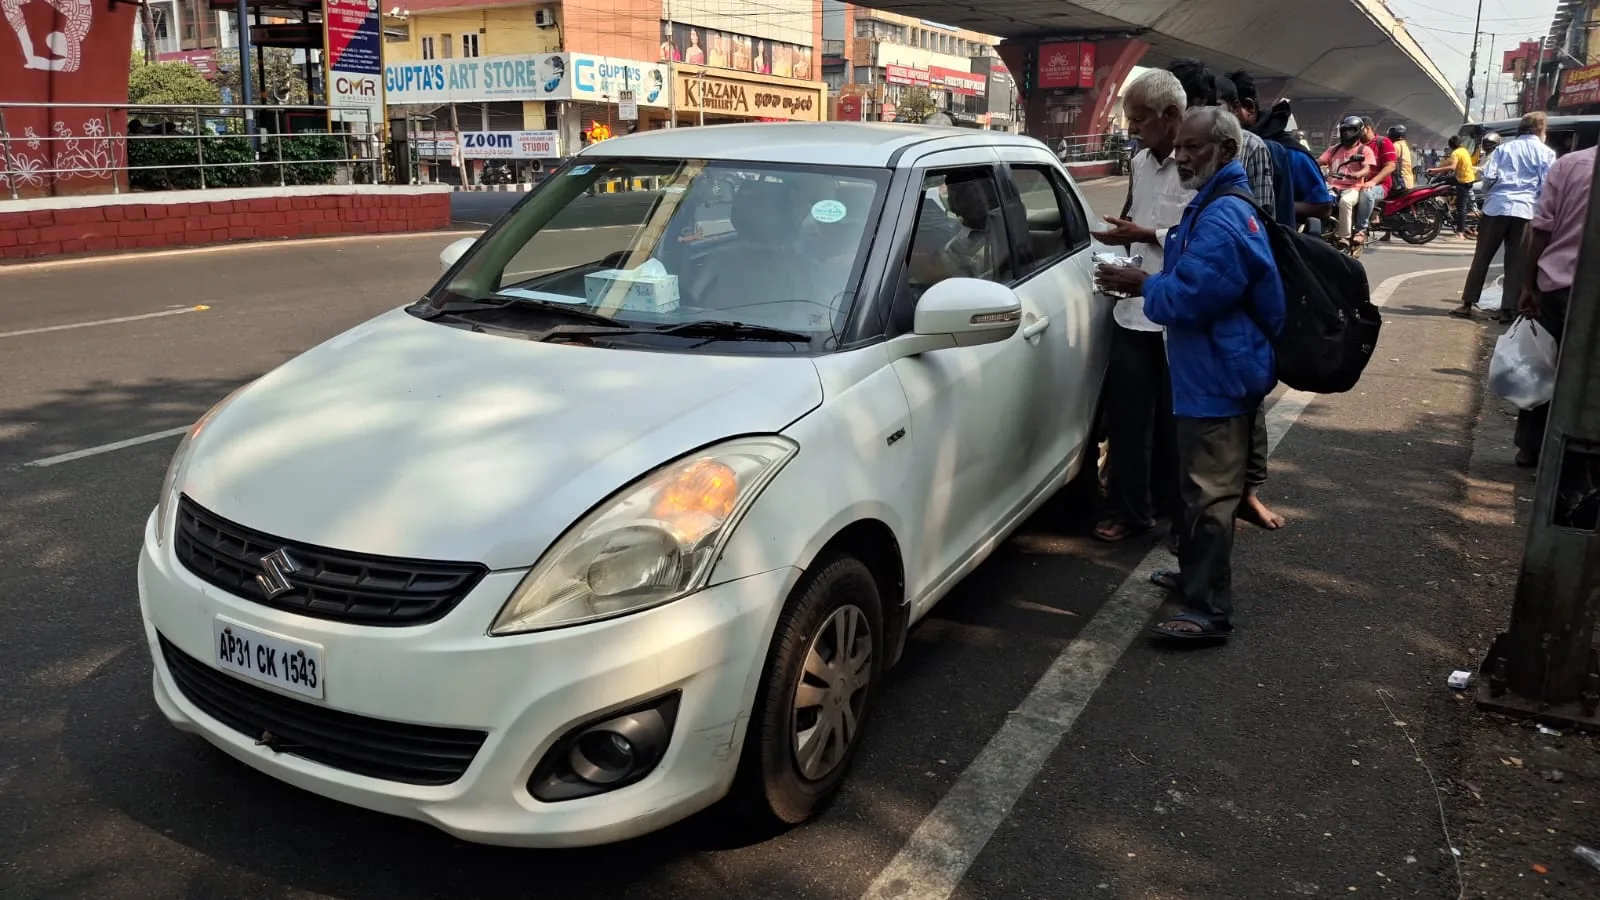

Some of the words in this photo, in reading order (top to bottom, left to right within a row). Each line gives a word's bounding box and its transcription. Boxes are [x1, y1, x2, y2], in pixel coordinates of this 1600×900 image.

[385, 64, 445, 92] GUPTA'S
[449, 63, 478, 89] ART
[484, 60, 536, 88] STORE
[598, 63, 641, 81] GUPTA'S
[336, 77, 376, 96] CMR
[684, 78, 749, 112] KHAZANA
[522, 142, 550, 152] STUDIO
[220, 632, 251, 669] AP31
[256, 644, 277, 678] CK
[282, 652, 317, 689] 1543
